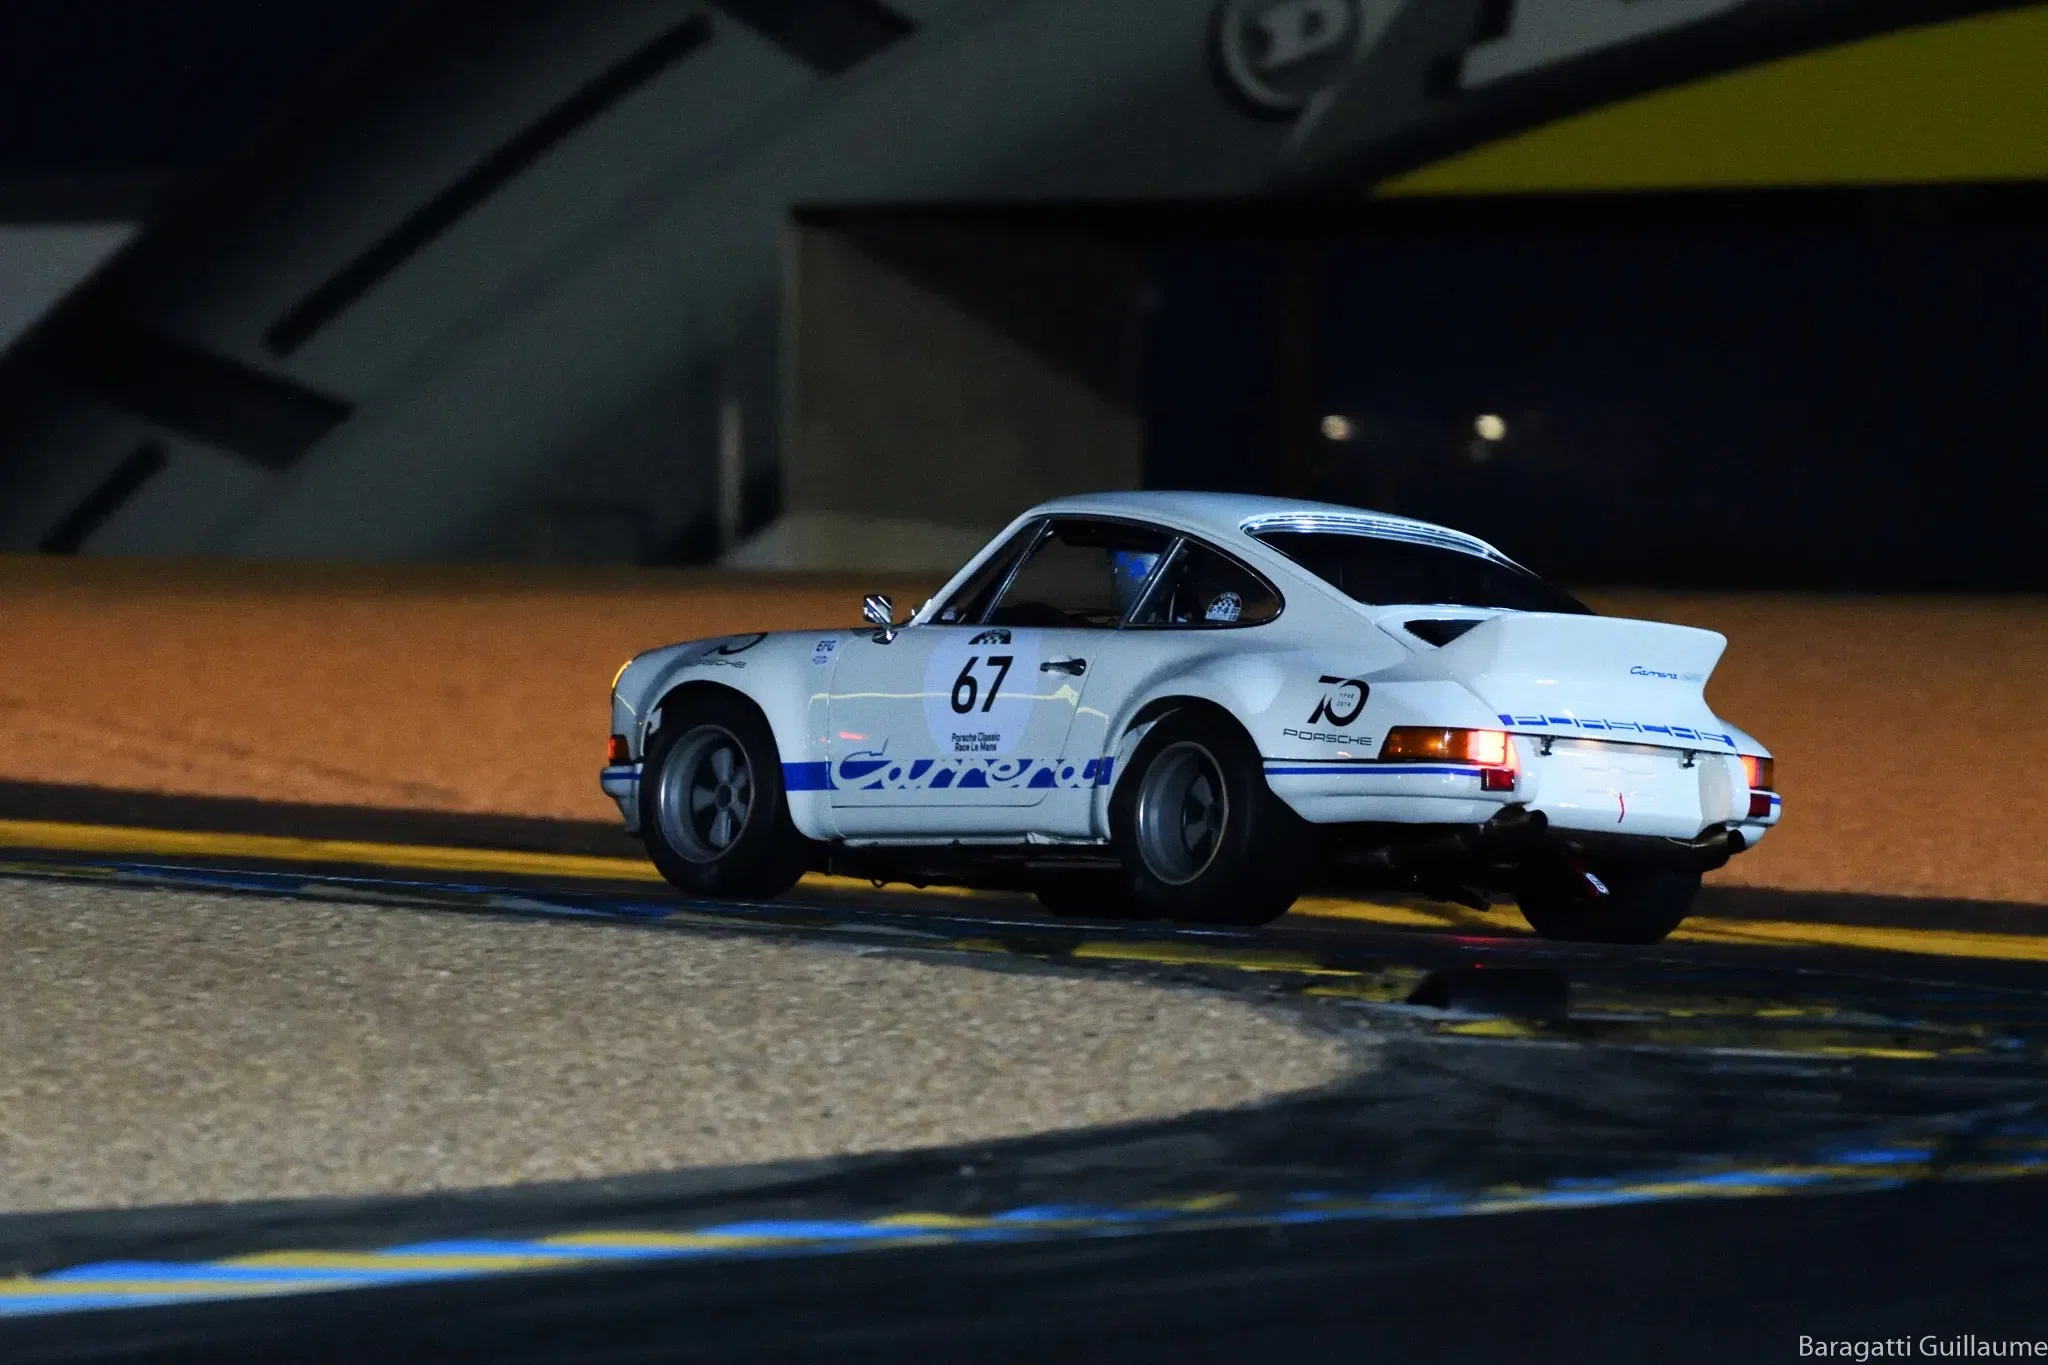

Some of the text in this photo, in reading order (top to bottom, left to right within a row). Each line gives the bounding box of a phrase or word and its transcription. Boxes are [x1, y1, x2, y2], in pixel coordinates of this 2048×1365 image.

[1630, 666, 1678, 679] Carrera
[951, 656, 1014, 714] 67
[1307, 675, 1370, 727] 70
[951, 731, 1000, 742] Porsche Classic
[1283, 728, 1372, 746] PORSCHE
[954, 742, 969, 752] Race
[980, 742, 997, 752] Mans
[830, 738, 1105, 790] Carrera
